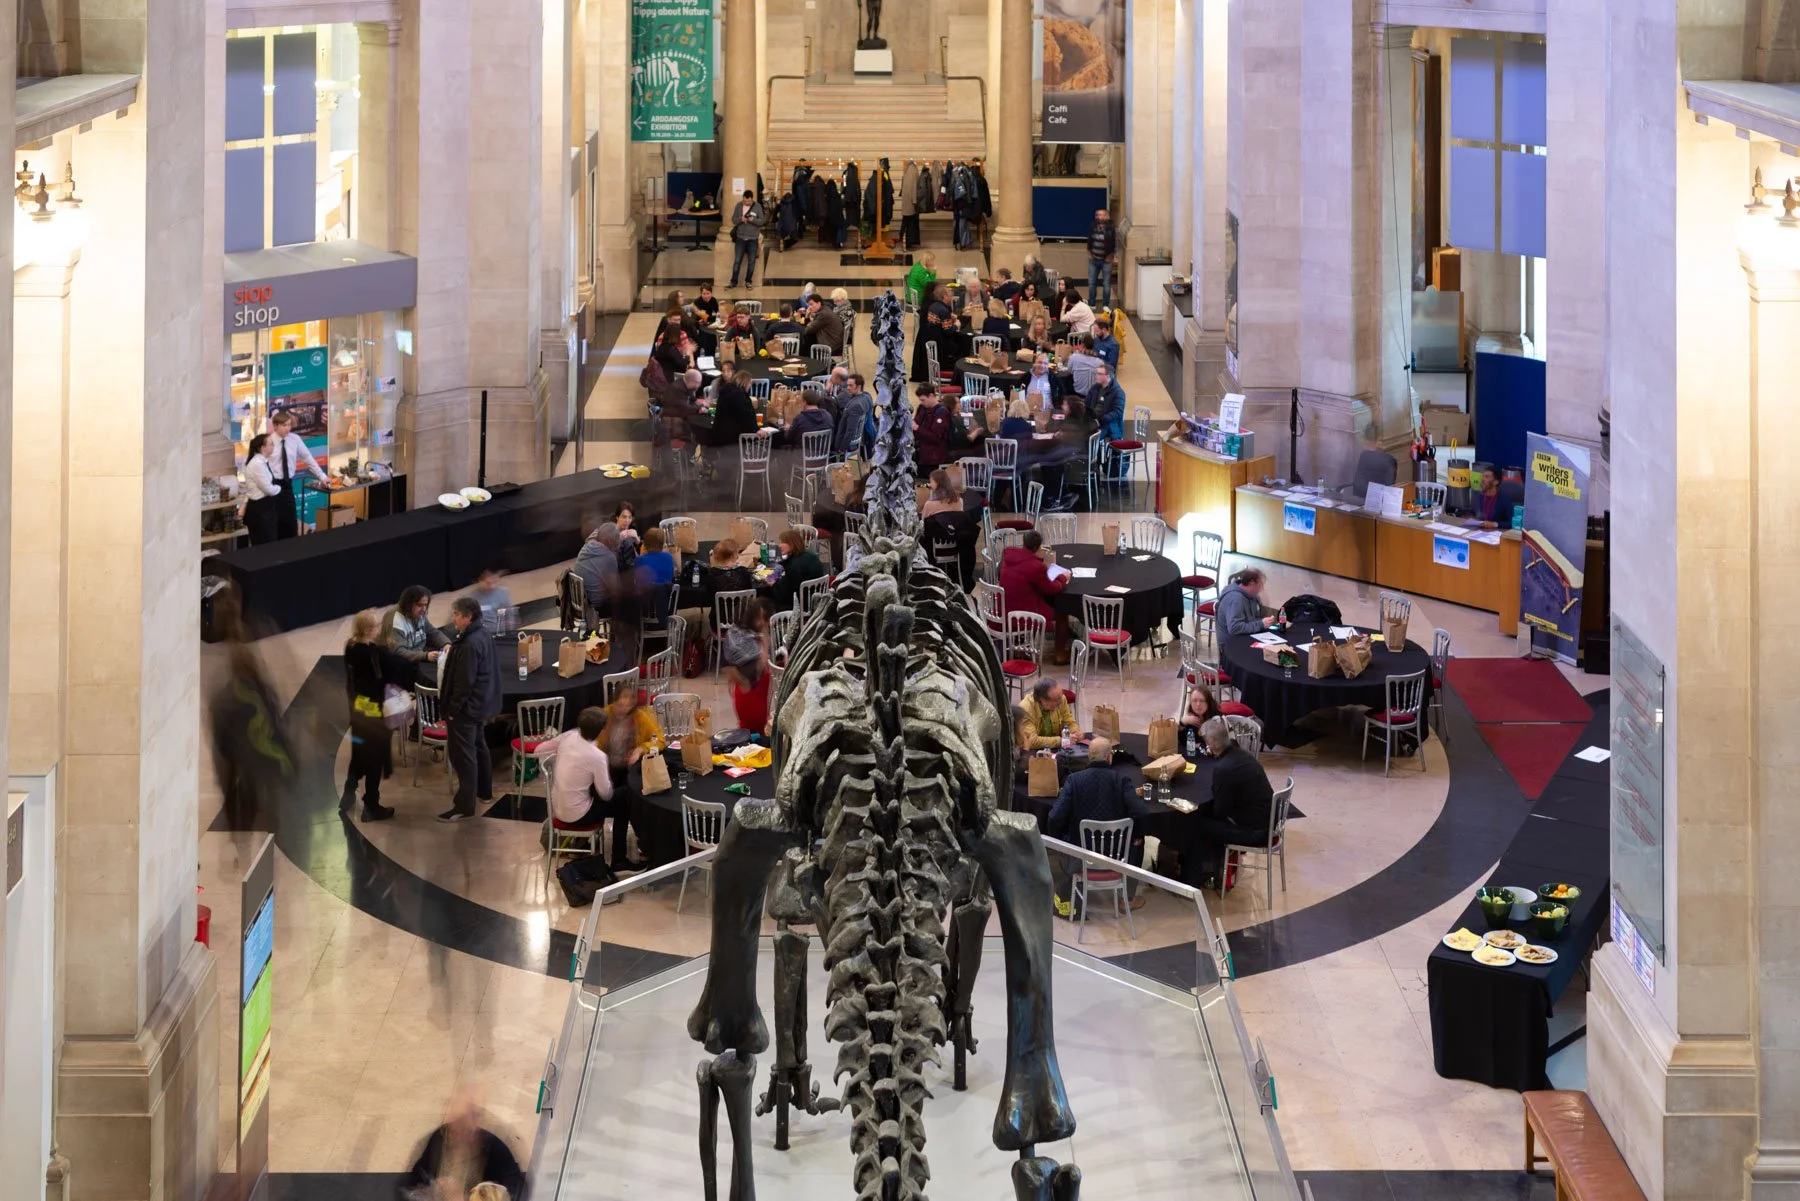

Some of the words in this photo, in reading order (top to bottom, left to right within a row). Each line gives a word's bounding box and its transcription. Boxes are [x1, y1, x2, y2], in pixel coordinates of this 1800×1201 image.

[633, 6, 657, 18] Dippy
[658, 6, 681, 16] about
[682, 6, 710, 16] Nature
[1048, 105, 1067, 113] Caffi
[1048, 116, 1067, 124] Cafe
[650, 123, 688, 131] EXHIBITION
[234, 284, 273, 305] siop
[235, 305, 279, 326] shop
[292, 366, 303, 375] AR
[1538, 463, 1569, 479] writers
[1546, 473, 1569, 487] room
